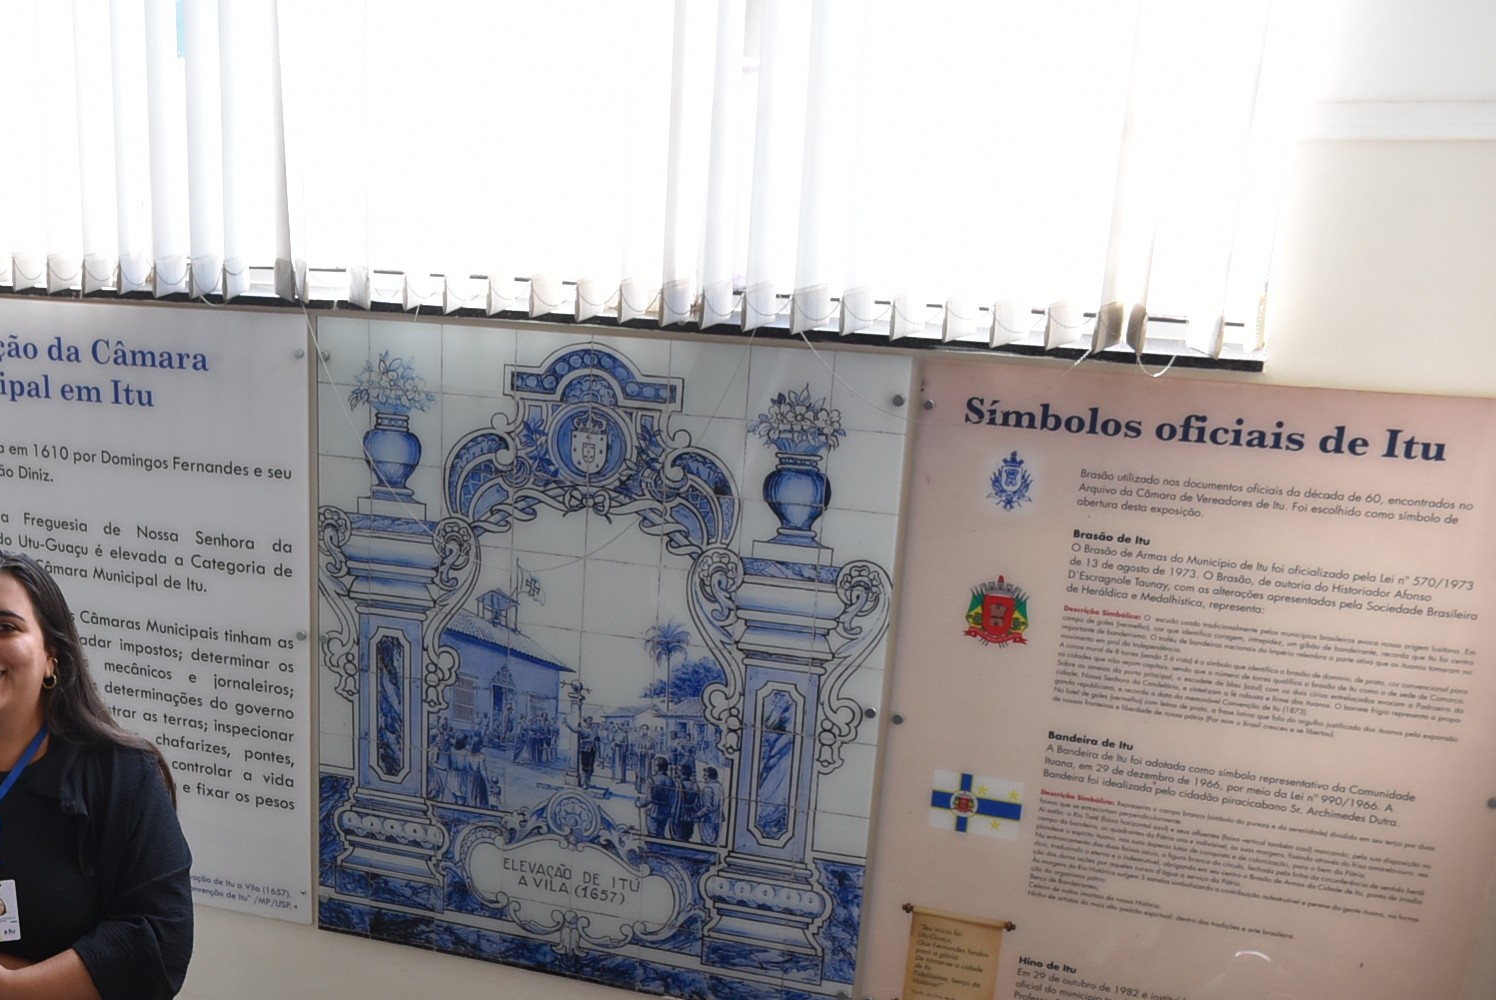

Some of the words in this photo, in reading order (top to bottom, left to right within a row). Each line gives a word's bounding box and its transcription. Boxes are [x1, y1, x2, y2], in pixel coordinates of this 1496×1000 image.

[46, 336, 82, 363] da
[90, 338, 209, 371] Câmara
[60, 383, 102, 403] em
[110, 379, 154, 407] Itu
[964, 396, 1142, 438] Símbolos
[1154, 413, 1304, 451] oficiais
[1318, 425, 1369, 456] de
[1381, 428, 1445, 461] Itu
[8, 444, 28, 456] em
[33, 443, 69, 460] 1610
[72, 451, 96, 464] por
[100, 449, 168, 472] Domingos
[172, 455, 249, 476] Fernandes
[253, 466, 262, 477] e
[267, 467, 291, 480] seu
[18, 464, 53, 482] Diniz.
[1079, 467, 1114, 481] Brasão
[1116, 471, 1160, 485] utilizado
[1162, 478, 1180, 487] nos
[1182, 476, 1243, 492] documentos
[1245, 482, 1283, 496] oficiais
[1285, 486, 1301, 497] da
[1303, 487, 1344, 501] década
[1346, 491, 1362, 502] de
[1364, 492, 1383, 505] 60,
[1387, 497, 1455, 509] encontrados
[1458, 502, 1474, 510] no
[1076, 495, 1118, 509] abertura
[1120, 499, 1147, 512] desta
[1149, 505, 1203, 517] exposição.
[0, 512, 9, 523] a
[23, 511, 87, 532] Freguesia
[102, 521, 120, 536] de
[136, 524, 178, 542] Nossa
[195, 530, 254, 550] Senhora
[271, 538, 292, 553] da
[1072, 528, 1113, 542] Brasão
[1116, 532, 1131, 544] de
[1134, 535, 1150, 546] Itu
[17, 533, 88, 558] Utu-Guaçu
[94, 543, 103, 557] é
[109, 545, 166, 564] elevada
[174, 556, 183, 566] a
[190, 553, 265, 575] Categoria
[273, 562, 292, 578] de
[92, 566, 158, 588] Municipal
[162, 574, 181, 589] de
[186, 576, 207, 592] Itu.
[79, 609, 140, 630] Câmaras
[145, 618, 218, 640] Municipais
[223, 628, 271, 646] tinham
[276, 638, 294, 649] as
[154, 732, 230, 758] chafarizes,
[244, 749, 294, 768] pontes,
[1047, 730, 1098, 745] Bandeira
[1100, 737, 1115, 748] de
[1118, 740, 1133, 750] Itu
[171, 760, 232, 778] controlar
[242, 771, 252, 781] a
[262, 771, 294, 788] vida
[182, 783, 191, 793] e
[195, 781, 230, 799] fixar
[234, 792, 250, 803] os
[255, 795, 295, 810] pesos
[502, 856, 572, 881] ELEVAÇÃO
[582, 870, 600, 886] DE
[517, 874, 528, 887] A
[532, 876, 569, 894] VILA
[573, 884, 625, 904] (1657)
[1018, 955, 1043, 968] Hino
[1045, 960, 1060, 971] de
[1062, 963, 1077, 974] Itu
